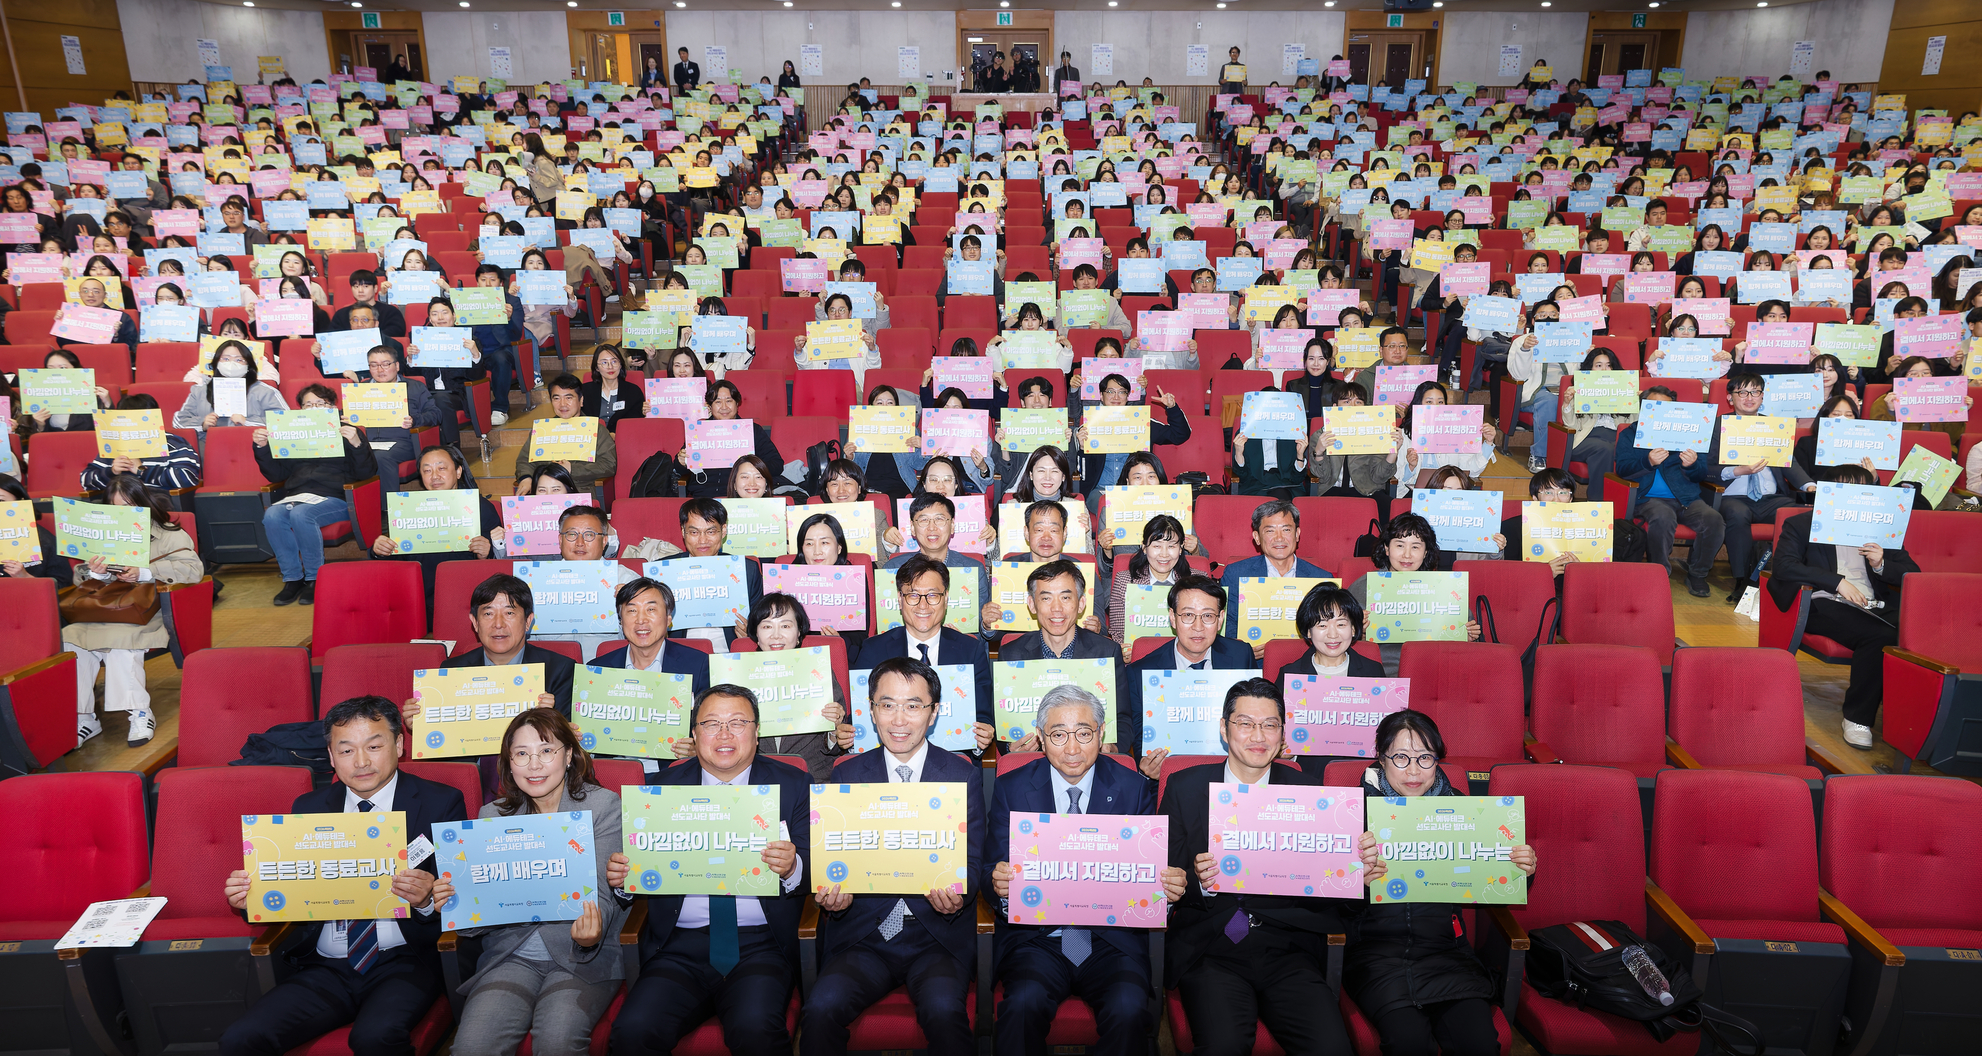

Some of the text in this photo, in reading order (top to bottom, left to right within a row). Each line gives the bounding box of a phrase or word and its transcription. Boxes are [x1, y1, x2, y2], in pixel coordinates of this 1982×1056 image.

[396, 515, 473, 530] 아낌없이 나누는
[1113, 510, 1143, 522] 든든한
[1451, 516, 1484, 528] 배우며
[1833, 509, 1895, 525] 함께 배우며
[62, 523, 144, 543] 아낌없이 나누는
[511, 521, 543, 532] 곁에서
[725, 523, 780, 534] 없이 나누는
[1530, 526, 1606, 539] 든든한 동료교사
[534, 590, 598, 605] 함께 배우며
[693, 585, 729, 599] 배우며
[810, 593, 858, 605] 지원하고
[1247, 606, 1282, 621] 든든한
[1374, 601, 1459, 614] 아낌없이 나누는
[752, 681, 824, 704] 없이 나누는
[425, 704, 472, 723] 든든한
[583, 702, 679, 725] 아낌없이 나누는
[1166, 705, 1220, 722] 함께 배우
[1293, 709, 1381, 727] 곁에서 지원하
[671, 812, 730, 820] 선도교사단 발대식
[860, 810, 918, 819] 선도교사단 발대식
[1257, 812, 1315, 821] 선도교사단 발대식
[294, 840, 356, 849] 선도교사단 발대식
[486, 840, 545, 853] 선도교사단 발대식
[636, 831, 769, 851] 아낌없이 나누는
[824, 829, 956, 851] 든든한 동료교사
[1059, 842, 1118, 851] 선도교사단 발대식
[1222, 830, 1352, 854] 곁에서 지원하고
[1382, 841, 1512, 861] 아낌없이 나누는
[257, 858, 396, 881] 든든한 동료교사
[470, 857, 567, 884] 함께 배우며
[1022, 860, 1156, 883] 곁에서 지원하고
